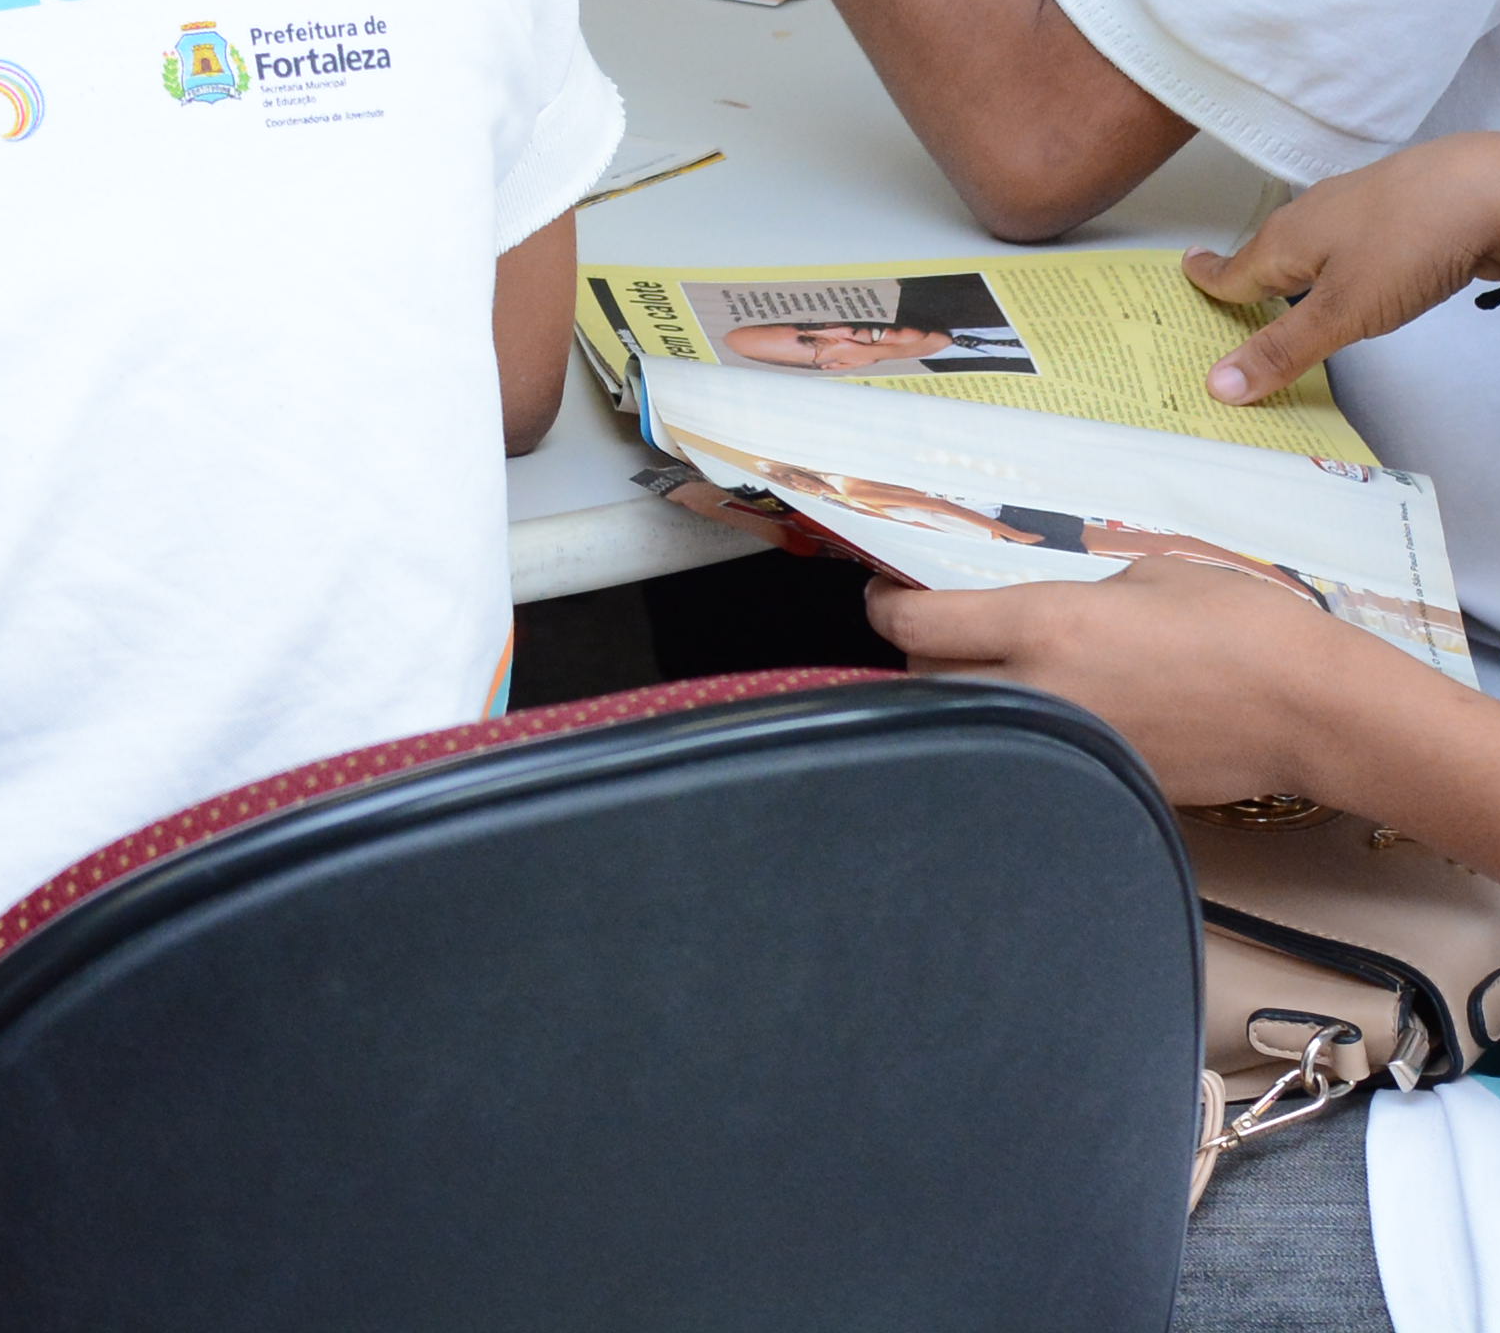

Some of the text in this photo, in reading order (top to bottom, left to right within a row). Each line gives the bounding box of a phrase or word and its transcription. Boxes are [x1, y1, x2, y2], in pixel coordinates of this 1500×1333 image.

[250, 15, 387, 46] Prefeitura de
[255, 43, 391, 80] Fortaleza
[305, 77, 347, 90] Municipal
[625, 281, 678, 320] calote
[653, 324, 684, 332] o
[1403, 522, 1416, 551] Fashion
[1410, 551, 1419, 573] Paulo
[1412, 572, 1422, 589] São
